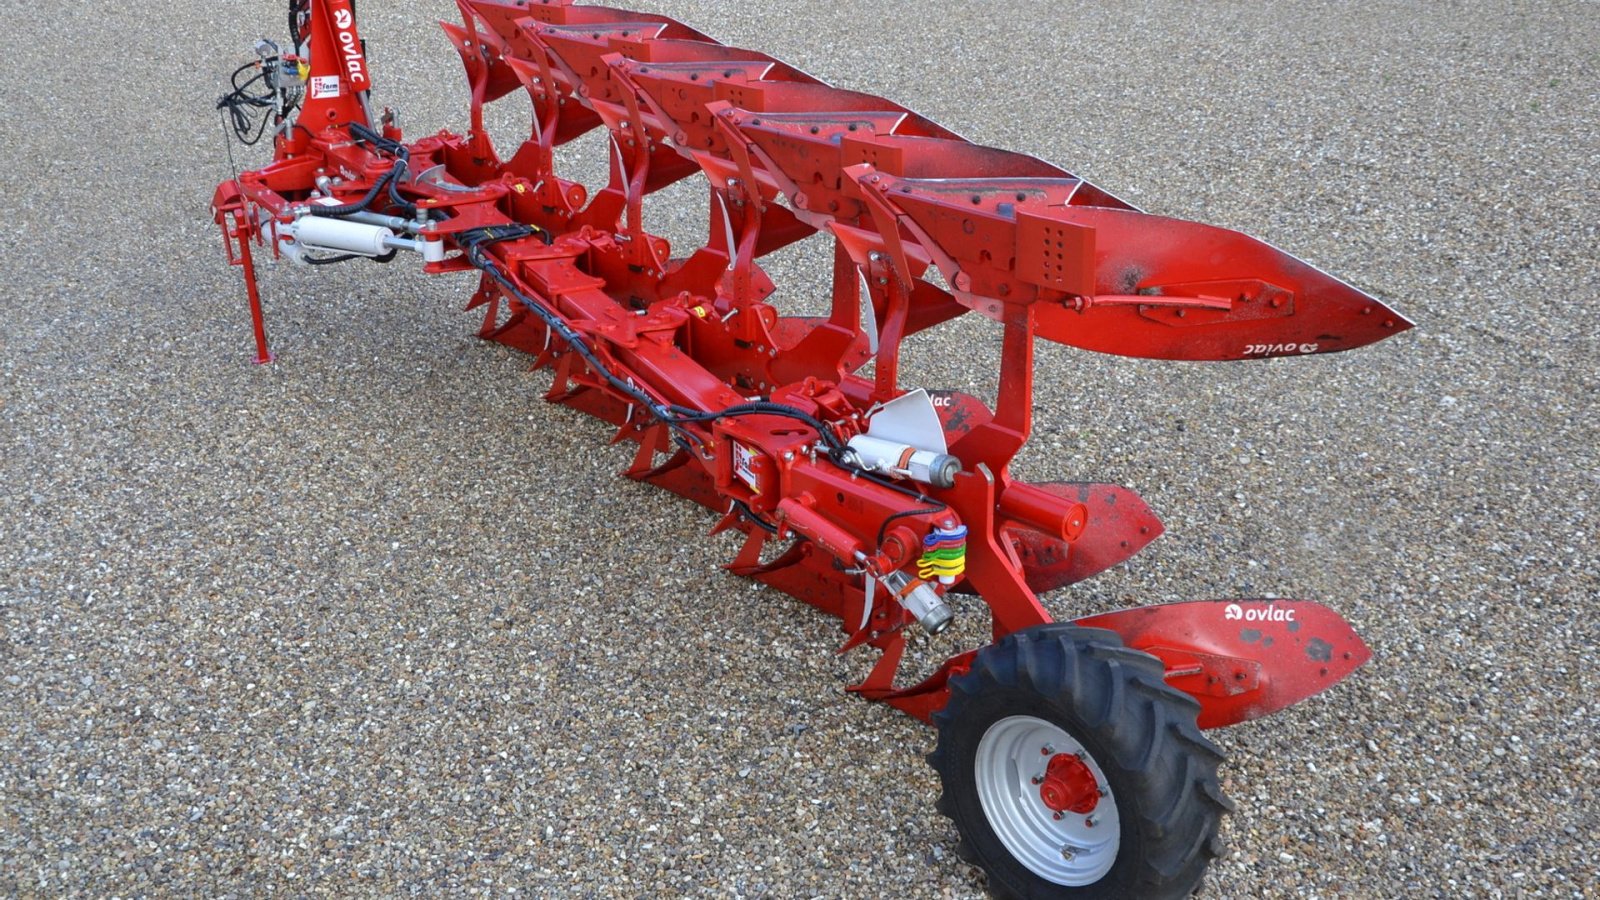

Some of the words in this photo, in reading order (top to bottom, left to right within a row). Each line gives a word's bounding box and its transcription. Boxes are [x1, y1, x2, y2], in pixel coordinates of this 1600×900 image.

[339, 31, 364, 83] ovlac
[1243, 342, 1297, 357] ovlac
[930, 393, 951, 407] lac
[1245, 604, 1296, 622] ovlac
